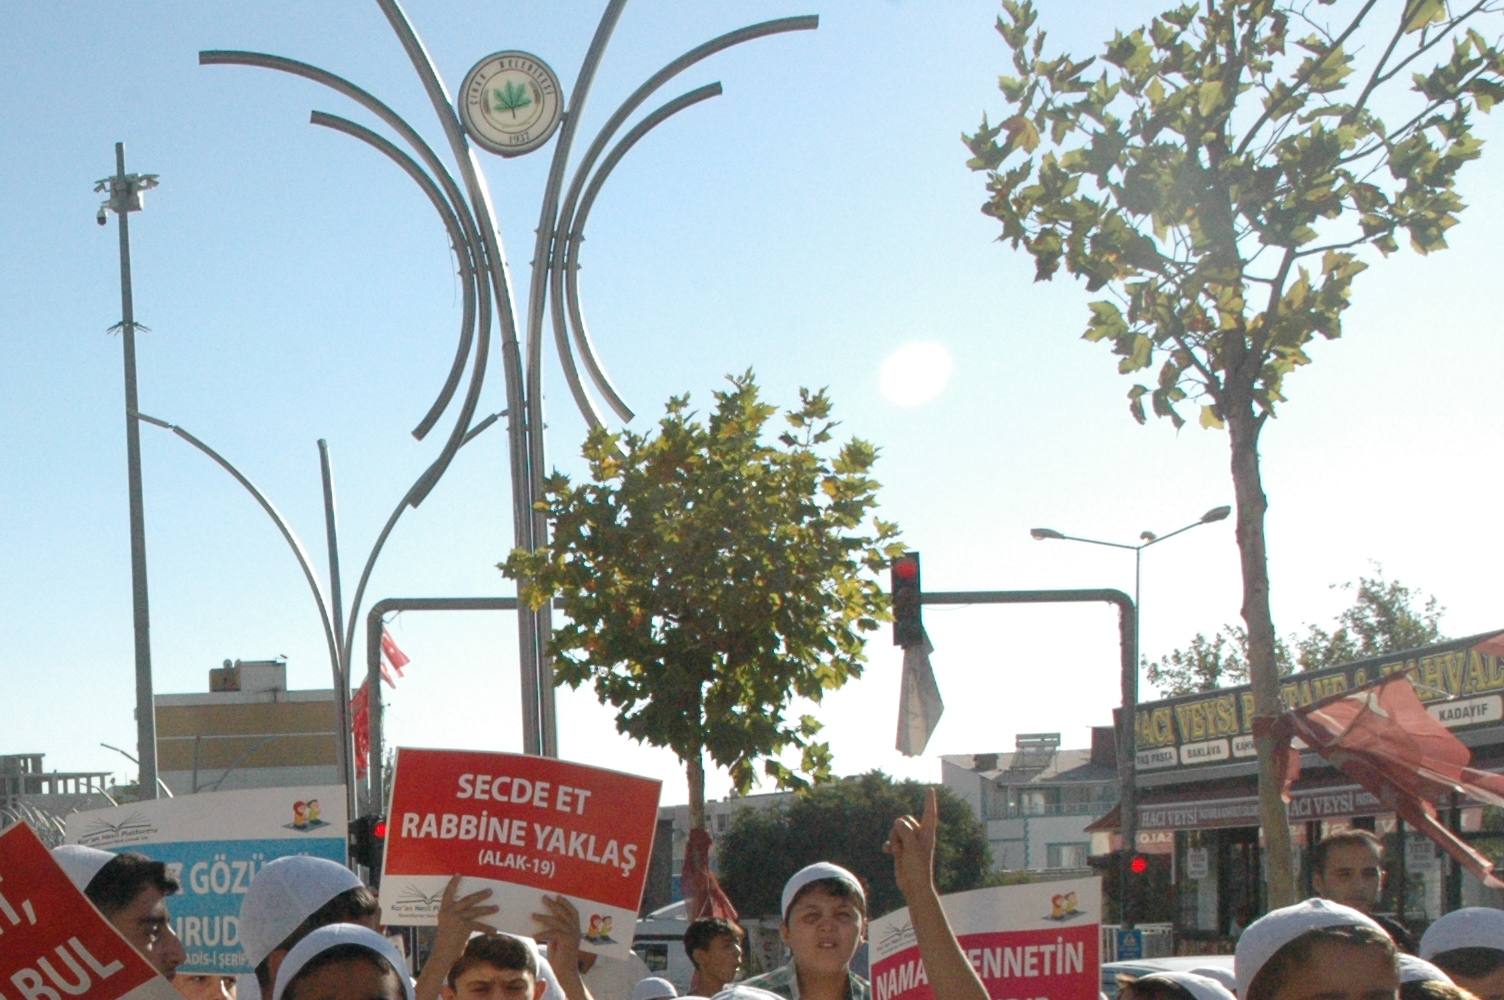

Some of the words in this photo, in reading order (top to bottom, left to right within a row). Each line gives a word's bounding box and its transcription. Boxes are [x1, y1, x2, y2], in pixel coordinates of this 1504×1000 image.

[1439, 703, 1489, 721] KADAYIF
[456, 773, 550, 808] SECDE
[556, 785, 592, 815] ET
[401, 810, 527, 847] RABBİNE
[533, 822, 638, 877] YAKLAŞ
[478, 849, 556, 878] (ALAK-19)
[968, 936, 1084, 979] ENNETİN
